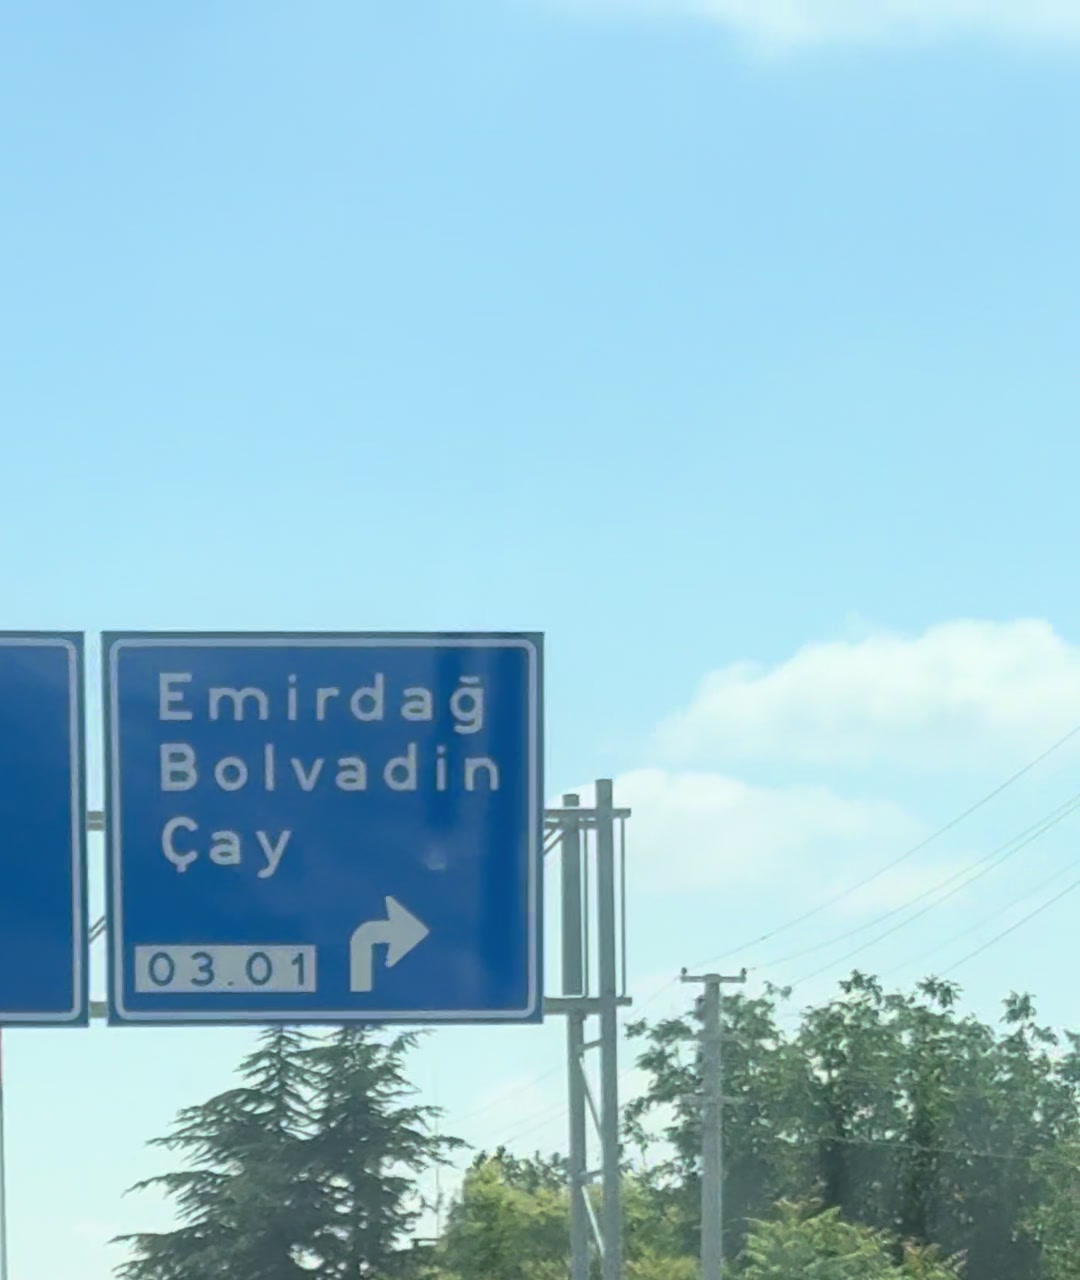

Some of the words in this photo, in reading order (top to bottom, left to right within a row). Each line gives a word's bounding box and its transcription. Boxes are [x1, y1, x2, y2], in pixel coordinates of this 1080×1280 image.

[158, 672, 485, 735] Emirdağ
[159, 742, 500, 792] Bolvadin
[160, 815, 292, 880] Çay
[147, 950, 307, 988] 03.01
